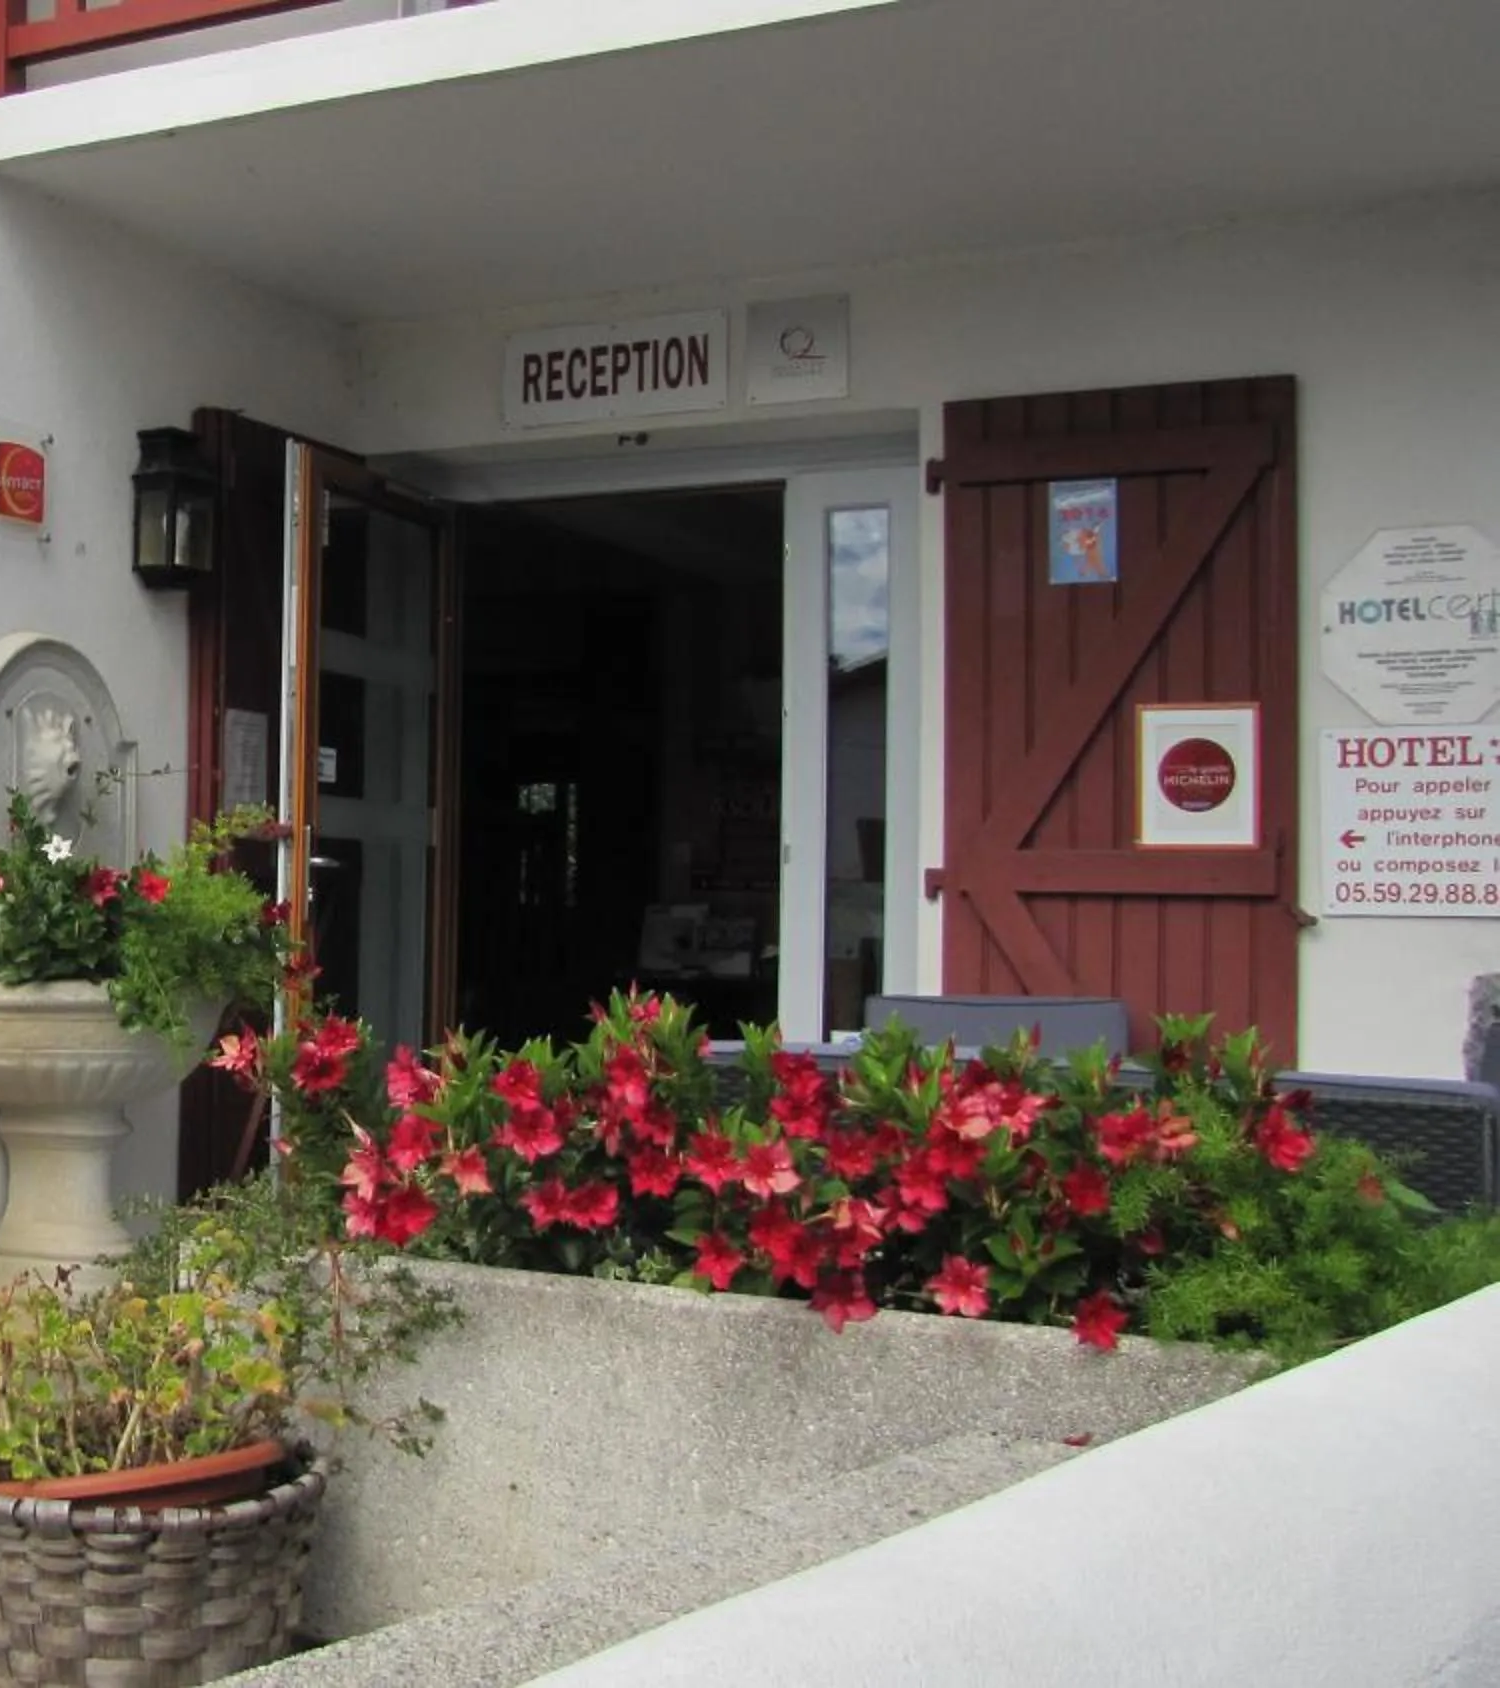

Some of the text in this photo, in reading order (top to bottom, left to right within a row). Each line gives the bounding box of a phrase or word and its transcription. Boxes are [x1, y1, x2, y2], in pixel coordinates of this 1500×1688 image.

[522, 333, 709, 404] RECEPTION
[1337, 735, 1484, 769] HOTEL
[1163, 774, 1230, 787] MICHELIN
[1355, 775, 1492, 796] Pour appeler
[1357, 805, 1487, 823] appuyez sur
[1337, 859, 1362, 873] ou
[1373, 858, 1482, 875] composez
[1335, 881, 1499, 906] 05.59.29.88.8
